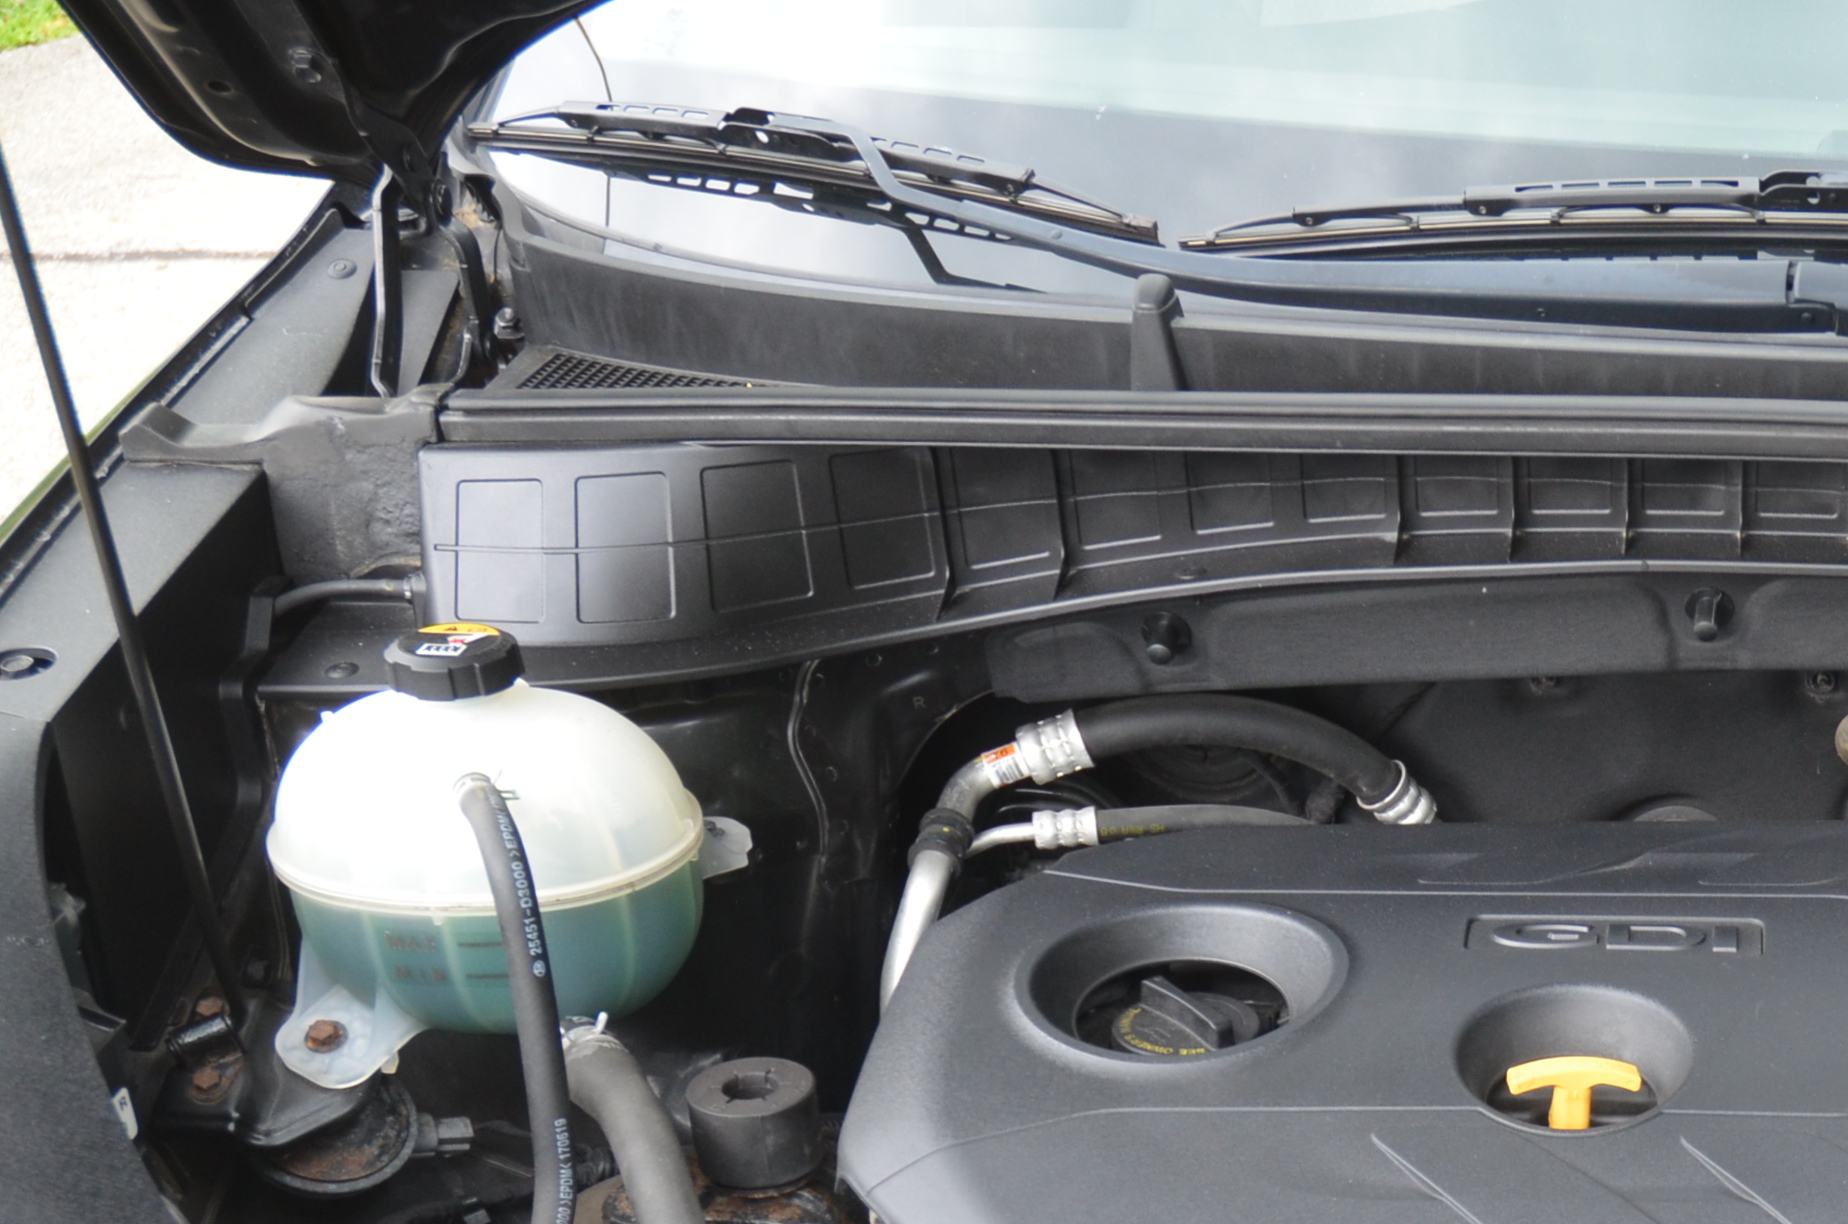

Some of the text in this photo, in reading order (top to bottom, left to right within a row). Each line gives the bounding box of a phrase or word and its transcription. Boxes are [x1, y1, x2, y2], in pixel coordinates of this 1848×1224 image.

[512, 862, 542, 956] 25451-D3000
[1492, 923, 1738, 953] GDI
[554, 1117, 571, 1160] 170619
